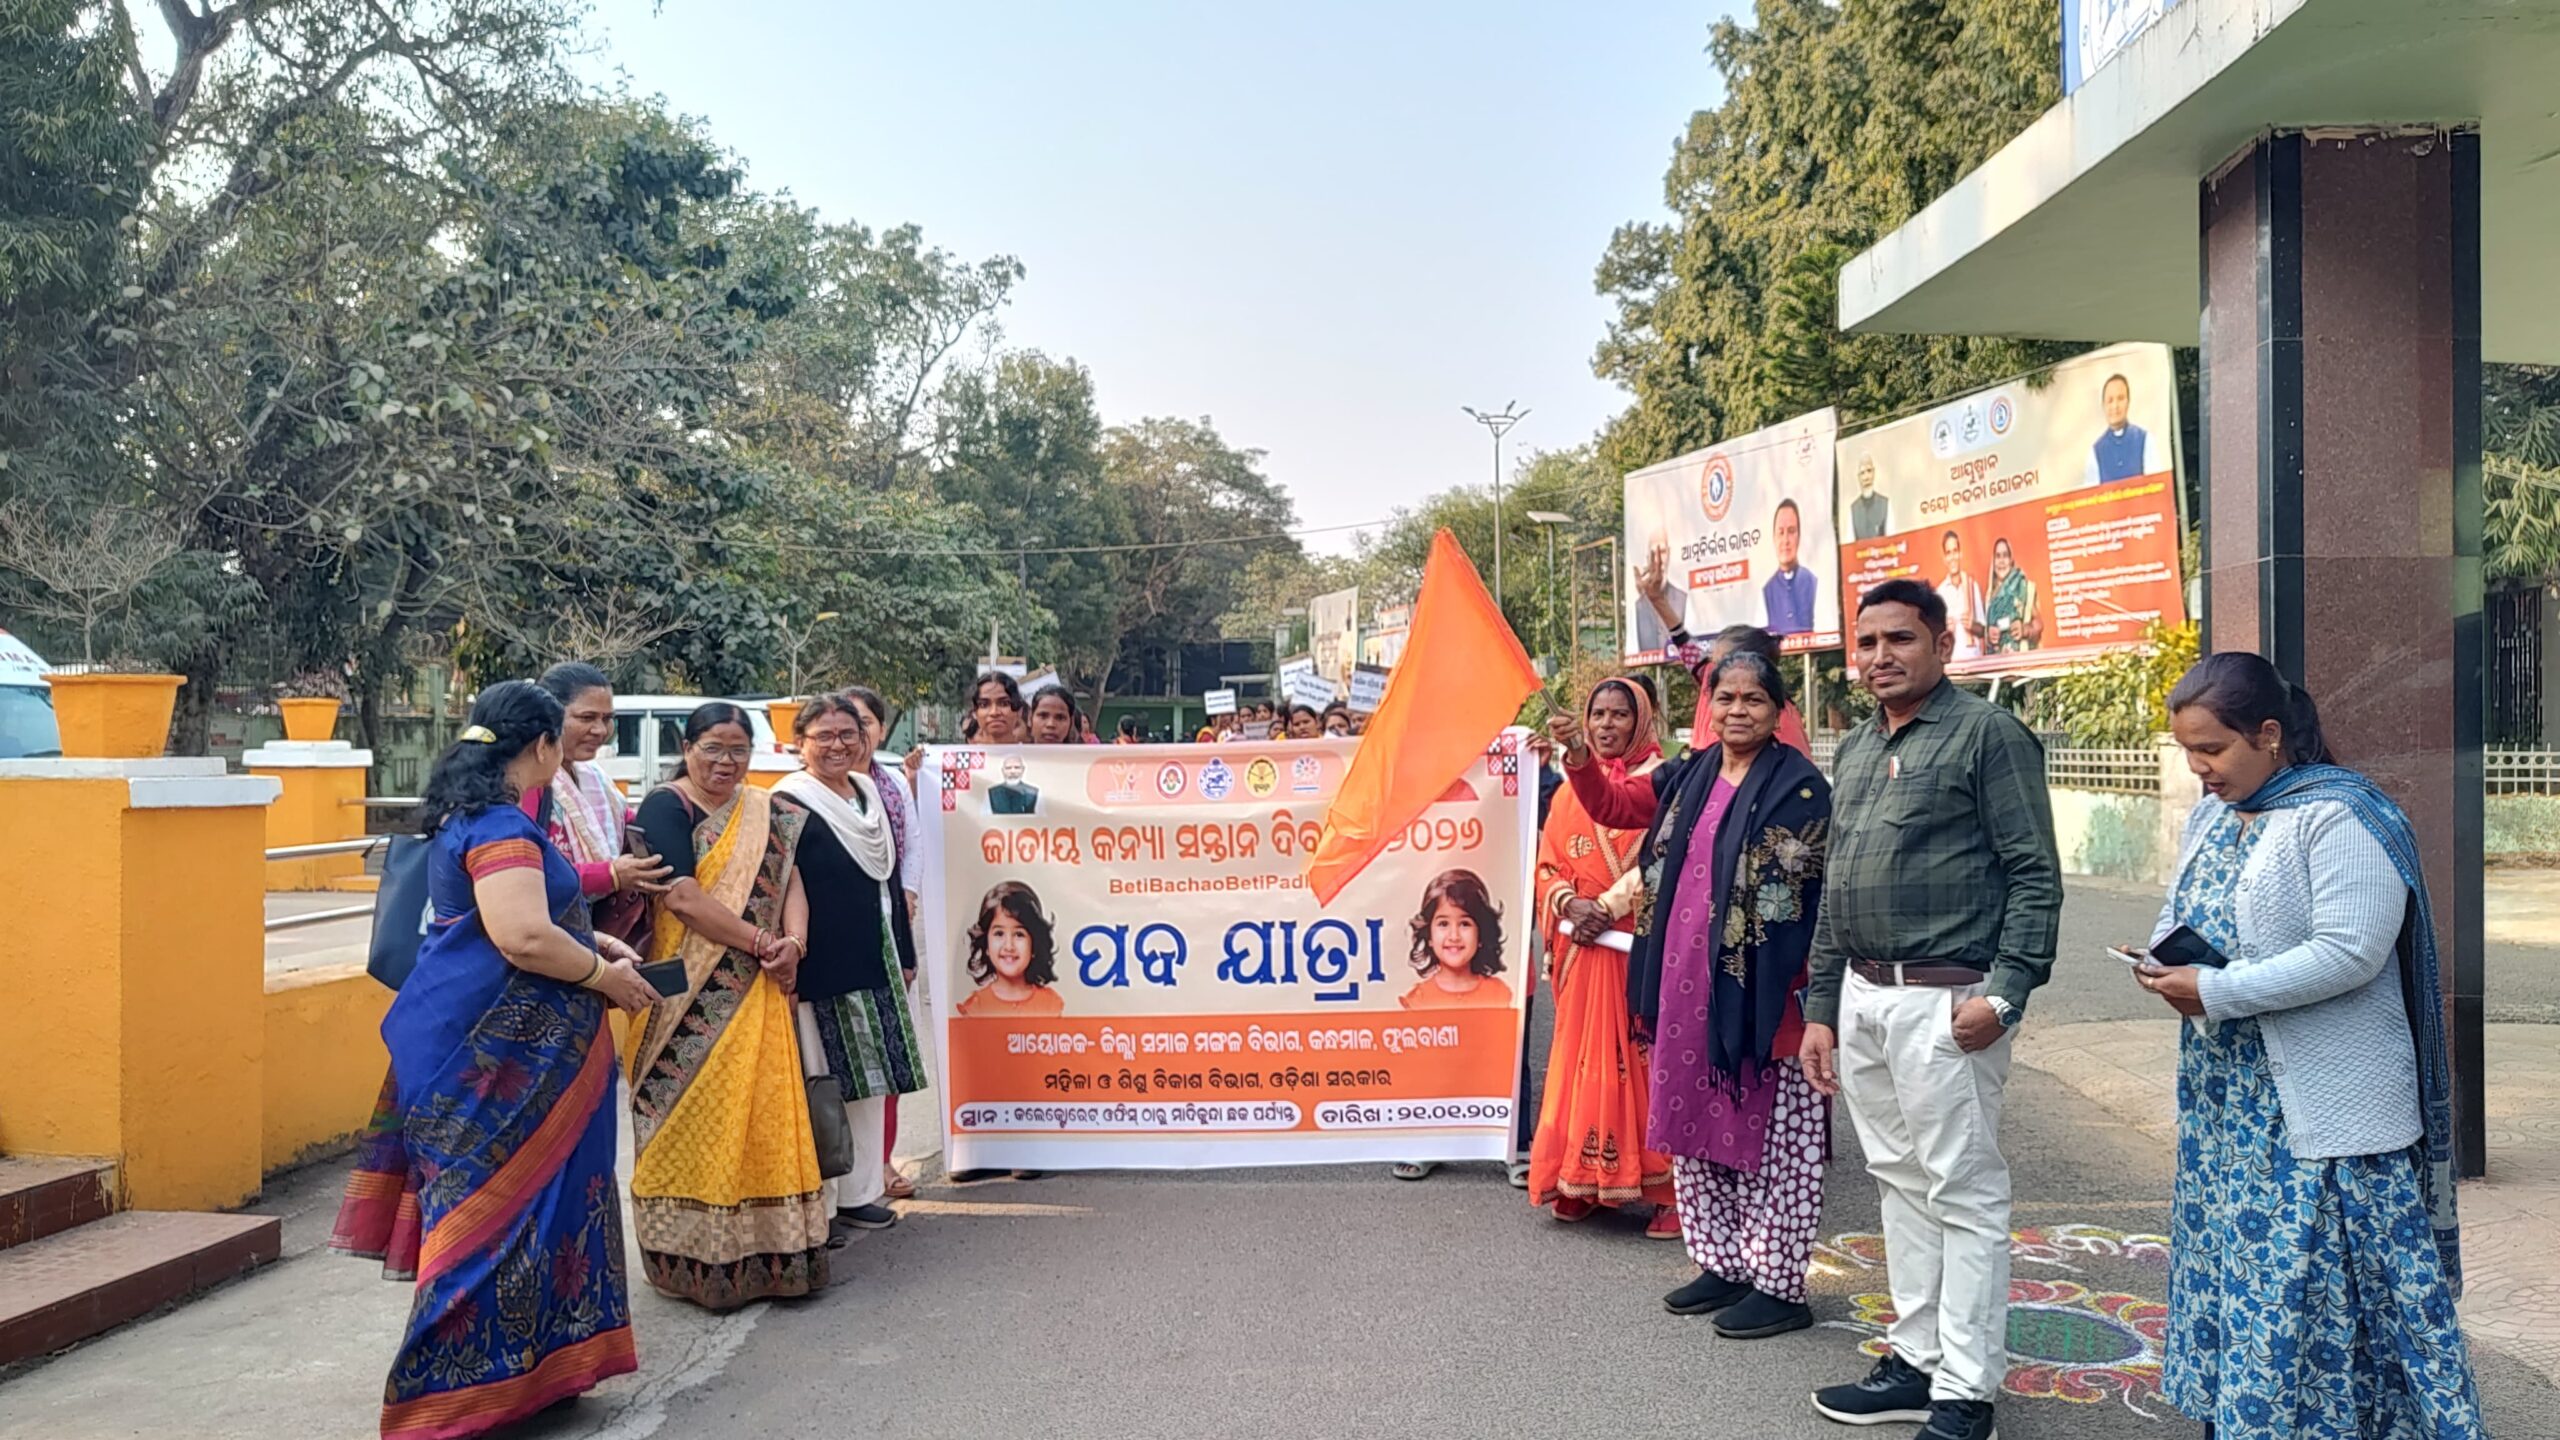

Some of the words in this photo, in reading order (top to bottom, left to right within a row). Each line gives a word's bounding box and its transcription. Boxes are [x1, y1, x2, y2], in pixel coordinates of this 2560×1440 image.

[1989, 470, 2040, 497] ଯୋଜନା
[981, 826, 1081, 864] ଜାତୀୟ
[1091, 825, 1165, 862] କନ୍ୟା
[1176, 822, 1260, 862] ସନ୍ତାନ
[1271, 809, 1323, 856] ଦିବ
[1109, 873, 1309, 894] BetiBachaoBetiPad
[1072, 922, 1187, 988] ପଦ
[1217, 918, 1386, 1002] ଯାତ୍ରା
[1100, 1026, 1136, 1061] ଜିଲ୍ଲା
[1141, 1032, 1189, 1054] ସମାଜ
[1194, 1031, 1242, 1053] ମଙ୍ଗଳ
[1382, 1025, 1459, 1054] ଫୁଲବାଣୀ
[1044, 1068, 1091, 1093] ମହିଳା
[1097, 1073, 1112, 1089] ଓ
[1118, 1068, 1148, 1093] ଶିଶୁ
[1153, 1067, 1202, 1090] ବିକାଶ
[1269, 1066, 1319, 1091] ଓଡ଼ିଶା
[1326, 1069, 1392, 1087] ସରକାର
[961, 1109, 997, 1126] ସ୍ଥାନ
[1142, 1107, 1167, 1125] ଠାରୁ
[1227, 1107, 1248, 1121] ଛକ
[1322, 1104, 1381, 1123] ତାରିଖ
[1399, 1104, 1510, 1120] ୨୧.୦୧.୨୦୨
